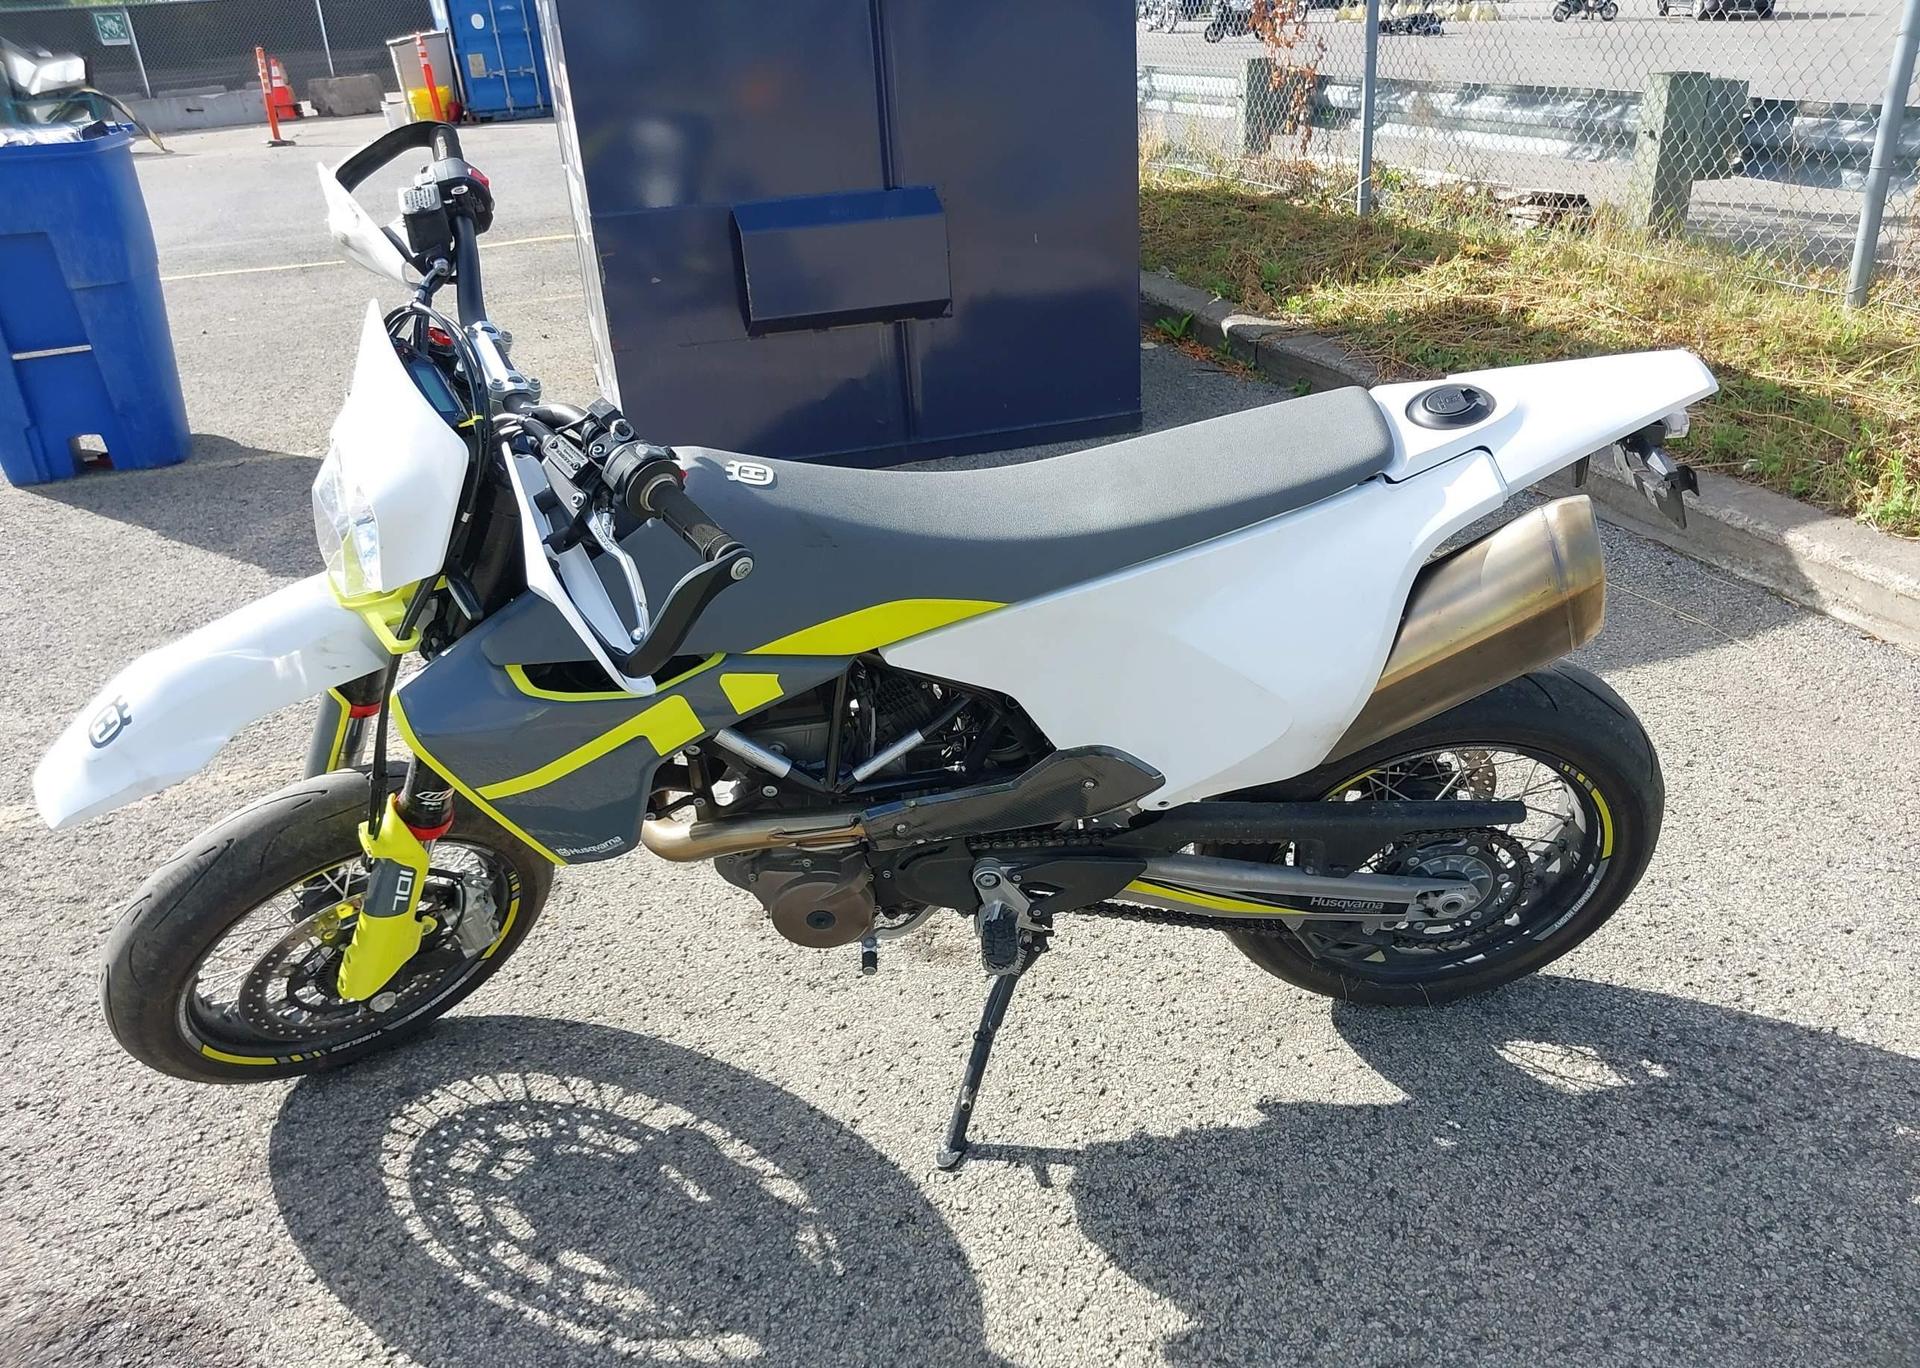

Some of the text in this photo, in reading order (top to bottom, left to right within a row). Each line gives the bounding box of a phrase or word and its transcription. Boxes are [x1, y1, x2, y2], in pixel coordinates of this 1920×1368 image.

[569, 836, 622, 855] Husqvarna
[392, 869, 414, 911] 701
[1310, 897, 1385, 909] Husqvarna
